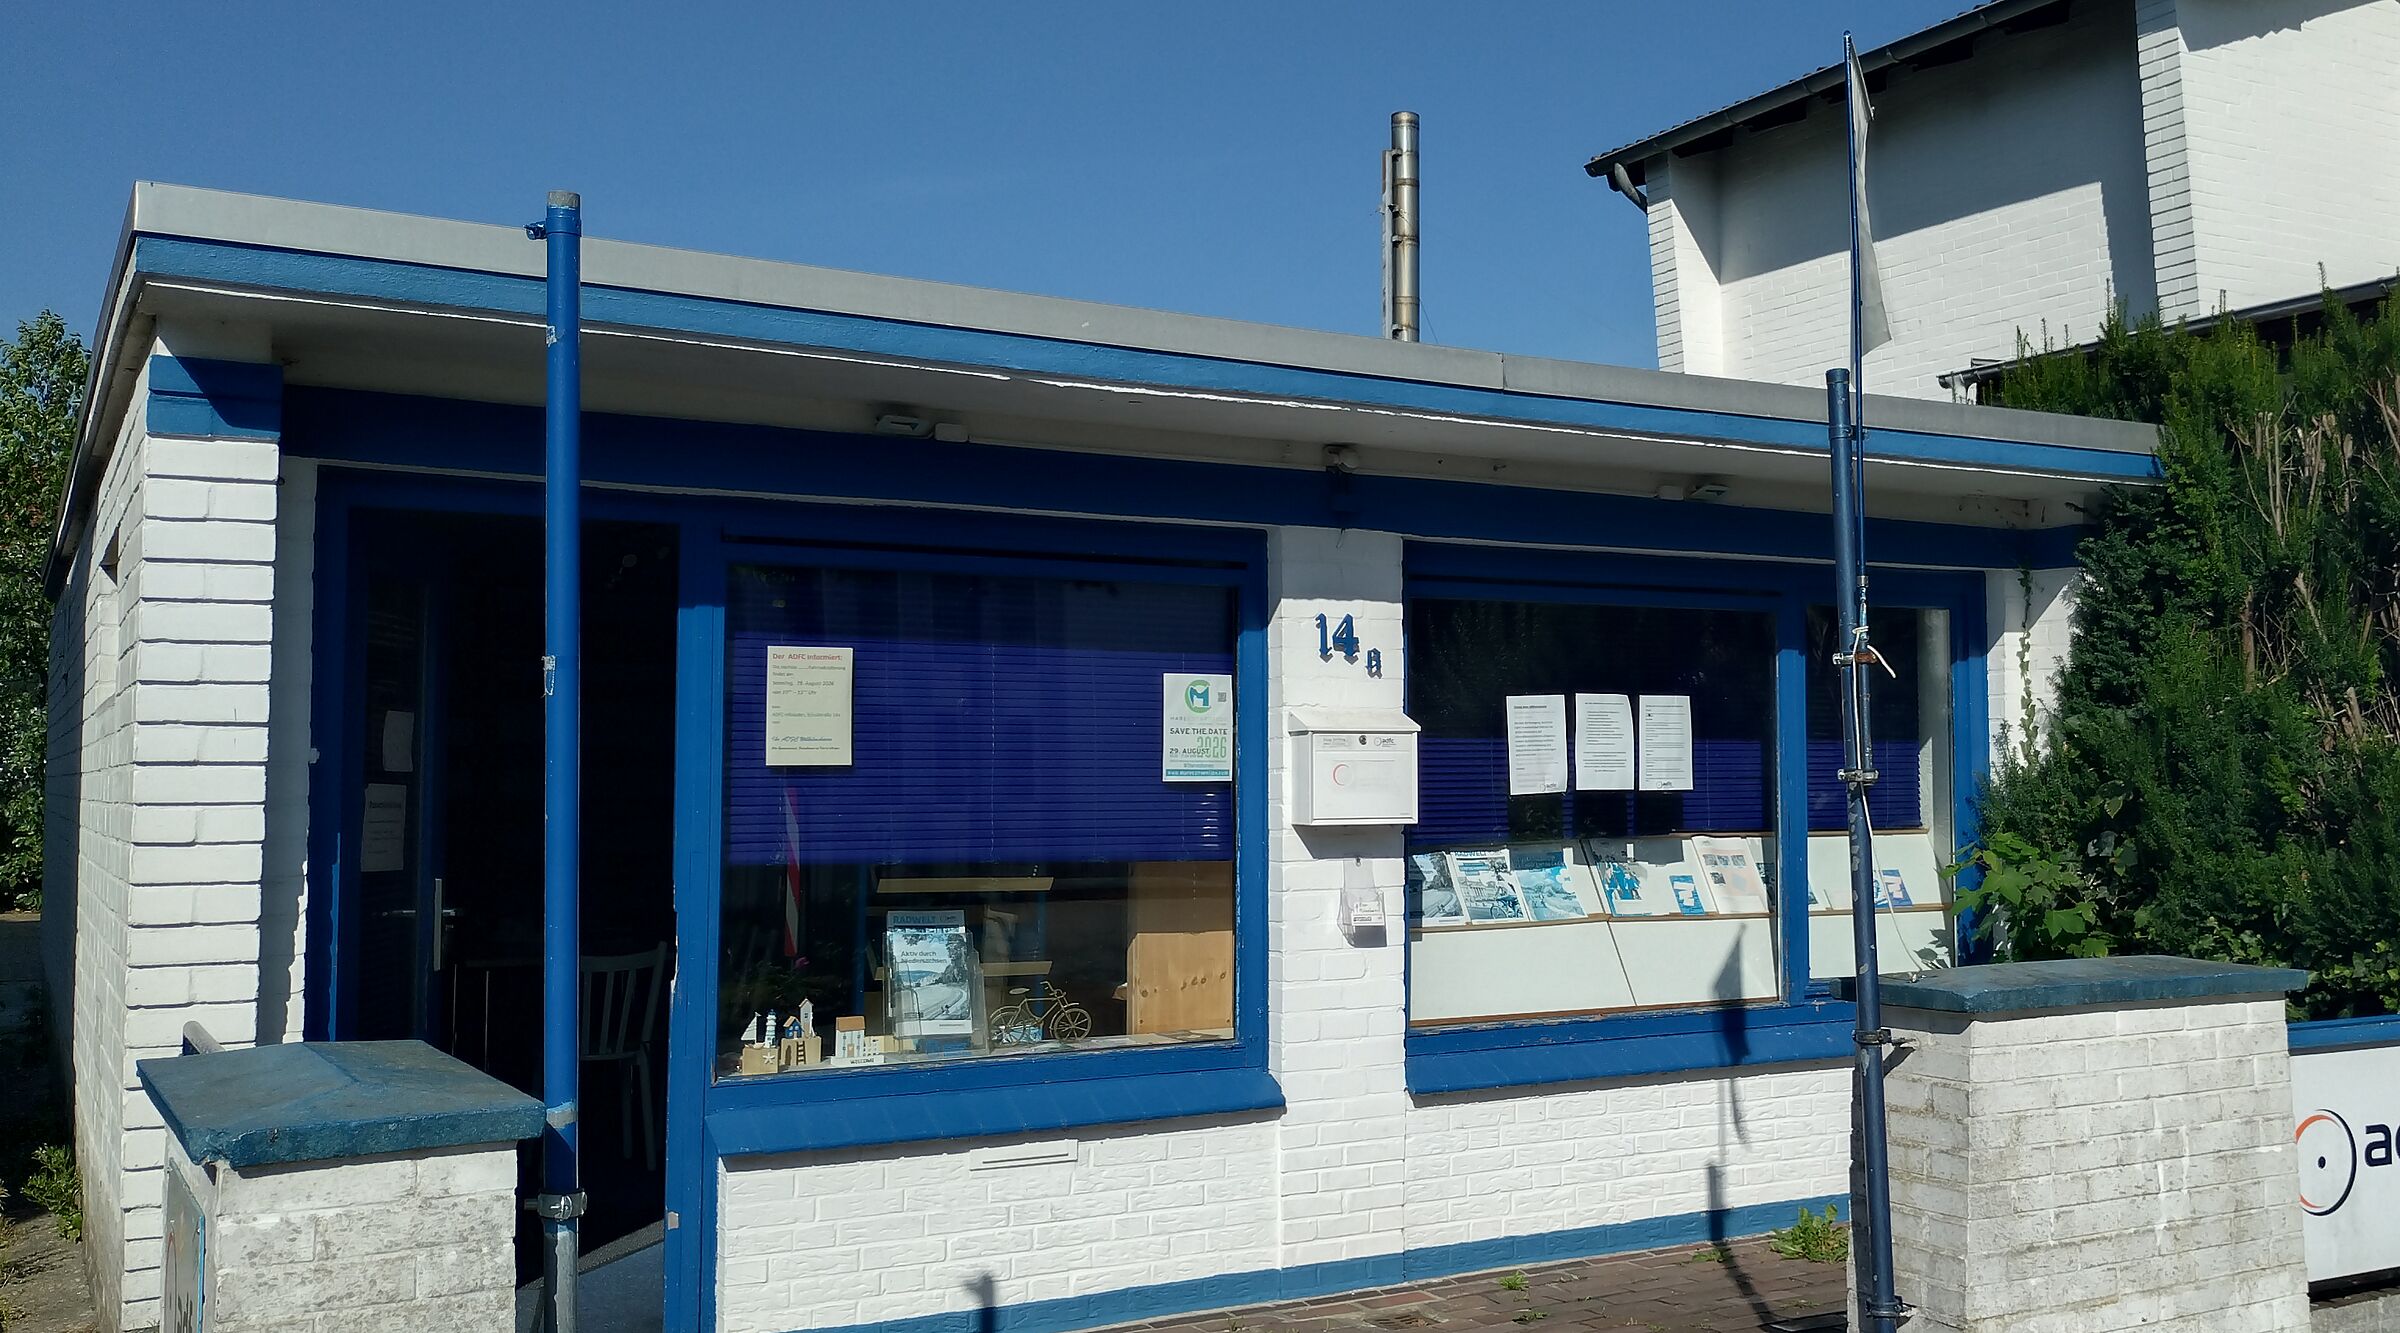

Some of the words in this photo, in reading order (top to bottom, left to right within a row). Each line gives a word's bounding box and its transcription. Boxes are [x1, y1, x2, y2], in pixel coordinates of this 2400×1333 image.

[1315, 613, 1360, 658] 14
[773, 653, 785, 661] Der
[788, 653, 806, 661] ADFC
[1170, 727, 1191, 735] SAVE
[1209, 728, 1228, 736] DATE
[1197, 736, 1227, 758] 2026
[893, 915, 936, 924] RADWELT
